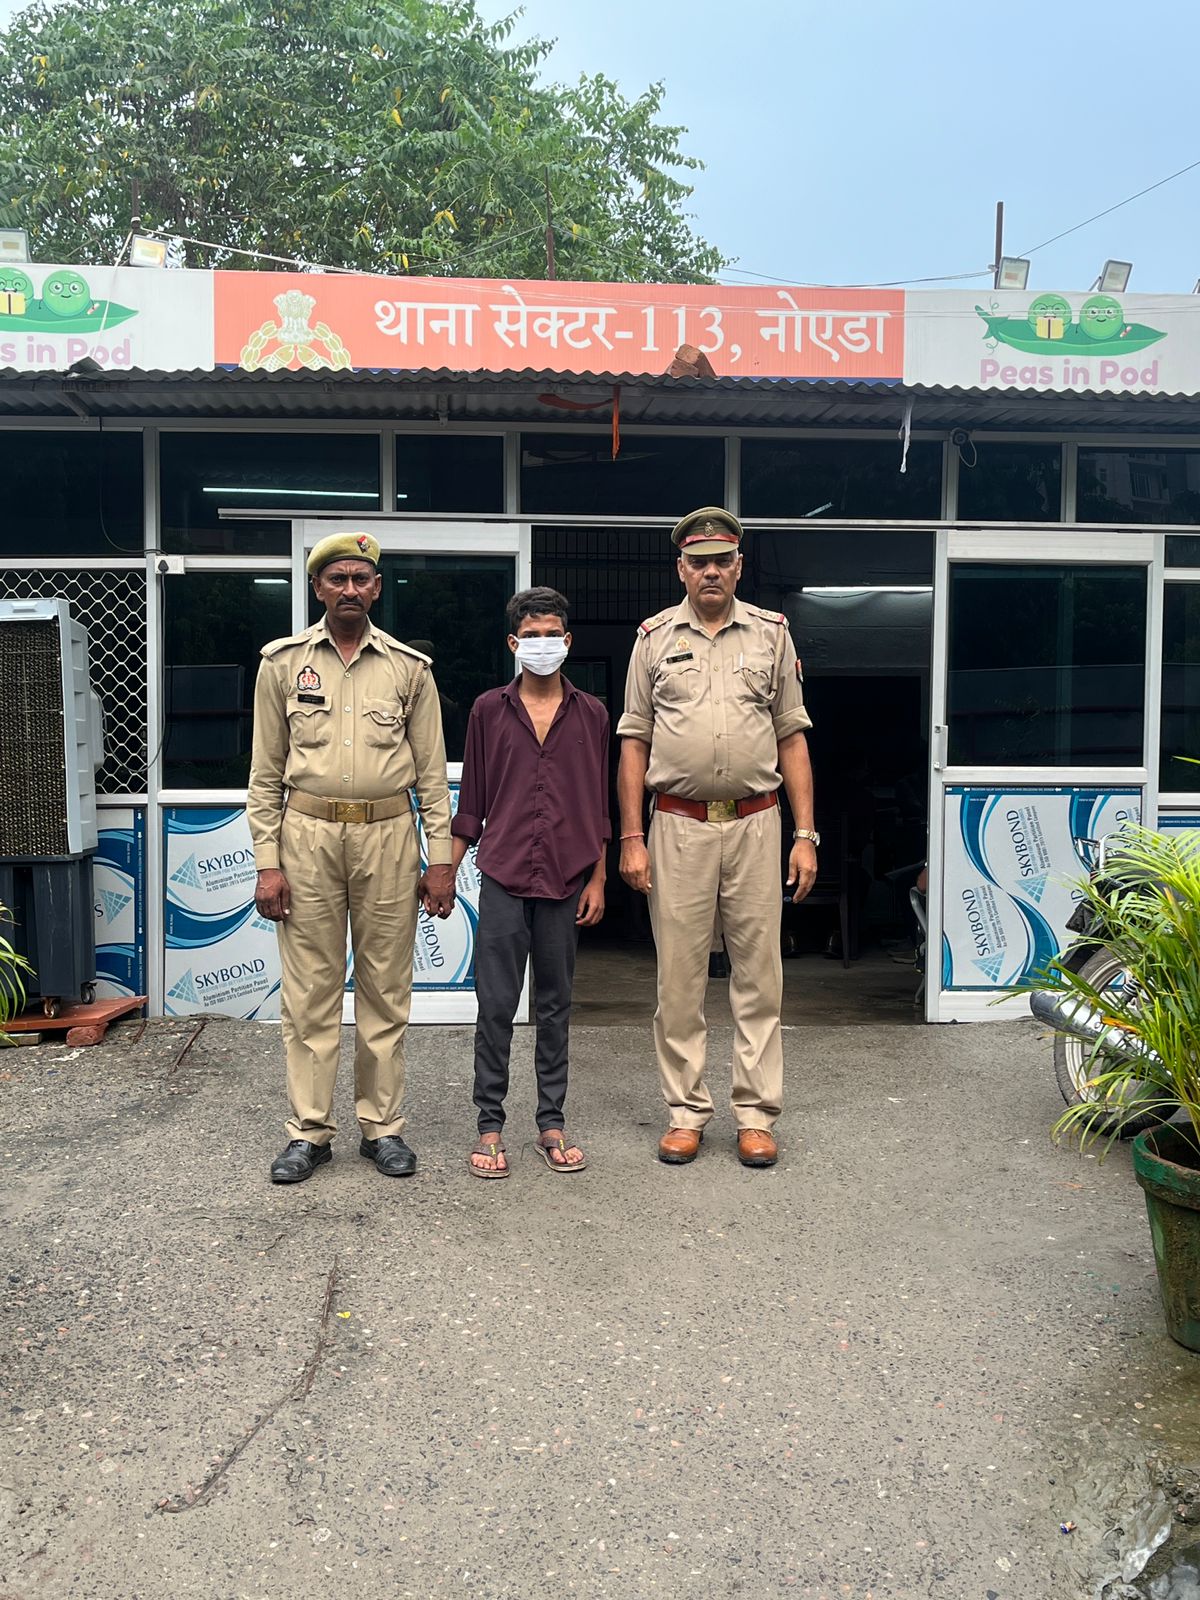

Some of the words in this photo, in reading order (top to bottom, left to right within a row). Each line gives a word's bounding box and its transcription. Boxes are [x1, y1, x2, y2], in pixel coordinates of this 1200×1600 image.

[374, 300, 481, 347] थाना
[755, 290, 892, 363] नोएडा
[27, 336, 56, 363] in
[67, 338, 131, 365] Pod
[980, 358, 1054, 385] Peas
[1064, 358, 1090, 385] in
[1100, 360, 1158, 386] Pod
[1006, 810, 1033, 876] SKYBOND
[198, 849, 254, 874] SKYBON
[962, 890, 990, 956] SKYBOND
[195, 959, 264, 989] SKYBOND
